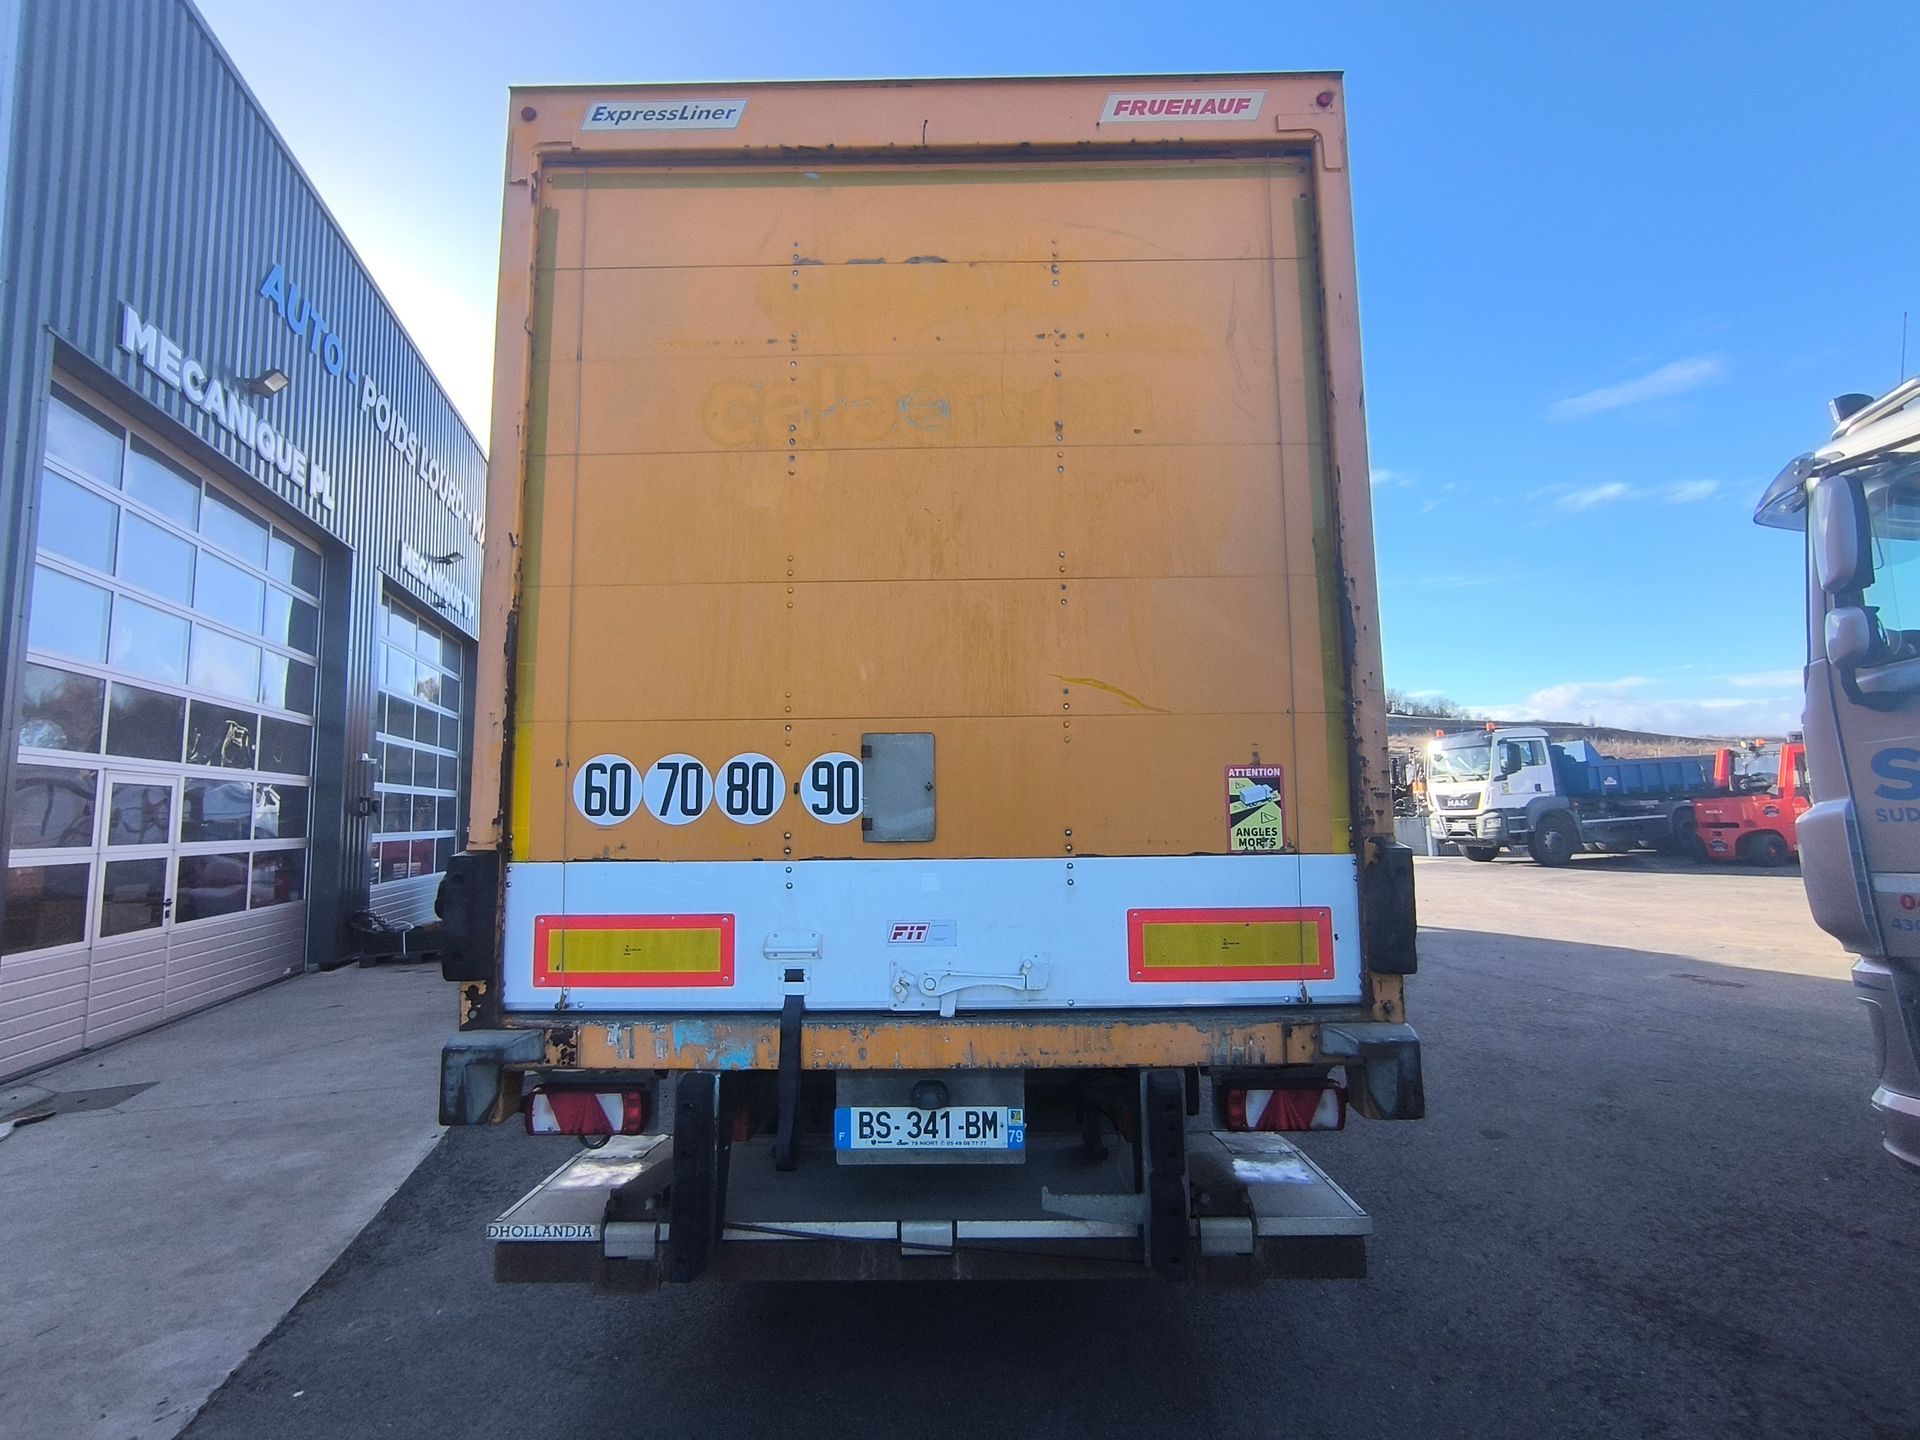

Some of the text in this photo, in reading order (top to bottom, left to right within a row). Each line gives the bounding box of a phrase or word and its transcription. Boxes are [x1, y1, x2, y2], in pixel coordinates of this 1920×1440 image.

[591, 105, 736, 125] ExpressLiner
[1113, 97, 1252, 116] FRUEHAUF
[260, 263, 343, 376] AUTO
[361, 374, 418, 466] POIDS
[419, 446, 464, 519] LOURD
[121, 304, 334, 511] MECANIQUE PL
[400, 540, 462, 616] MECANIQUE
[1228, 768, 1281, 777] ATTENTION
[584, 762, 632, 817] 60
[656, 762, 704, 817] 70
[726, 761, 774, 816] 80
[811, 761, 860, 816] 90
[1446, 799, 1469, 807] MAN
[1235, 827, 1278, 837] ANGLES
[1238, 837, 1277, 848] MORTS
[838, 1132, 845, 1140] F
[1008, 1129, 1024, 1143] 79
[487, 1225, 593, 1238] DHOLLANDIA
